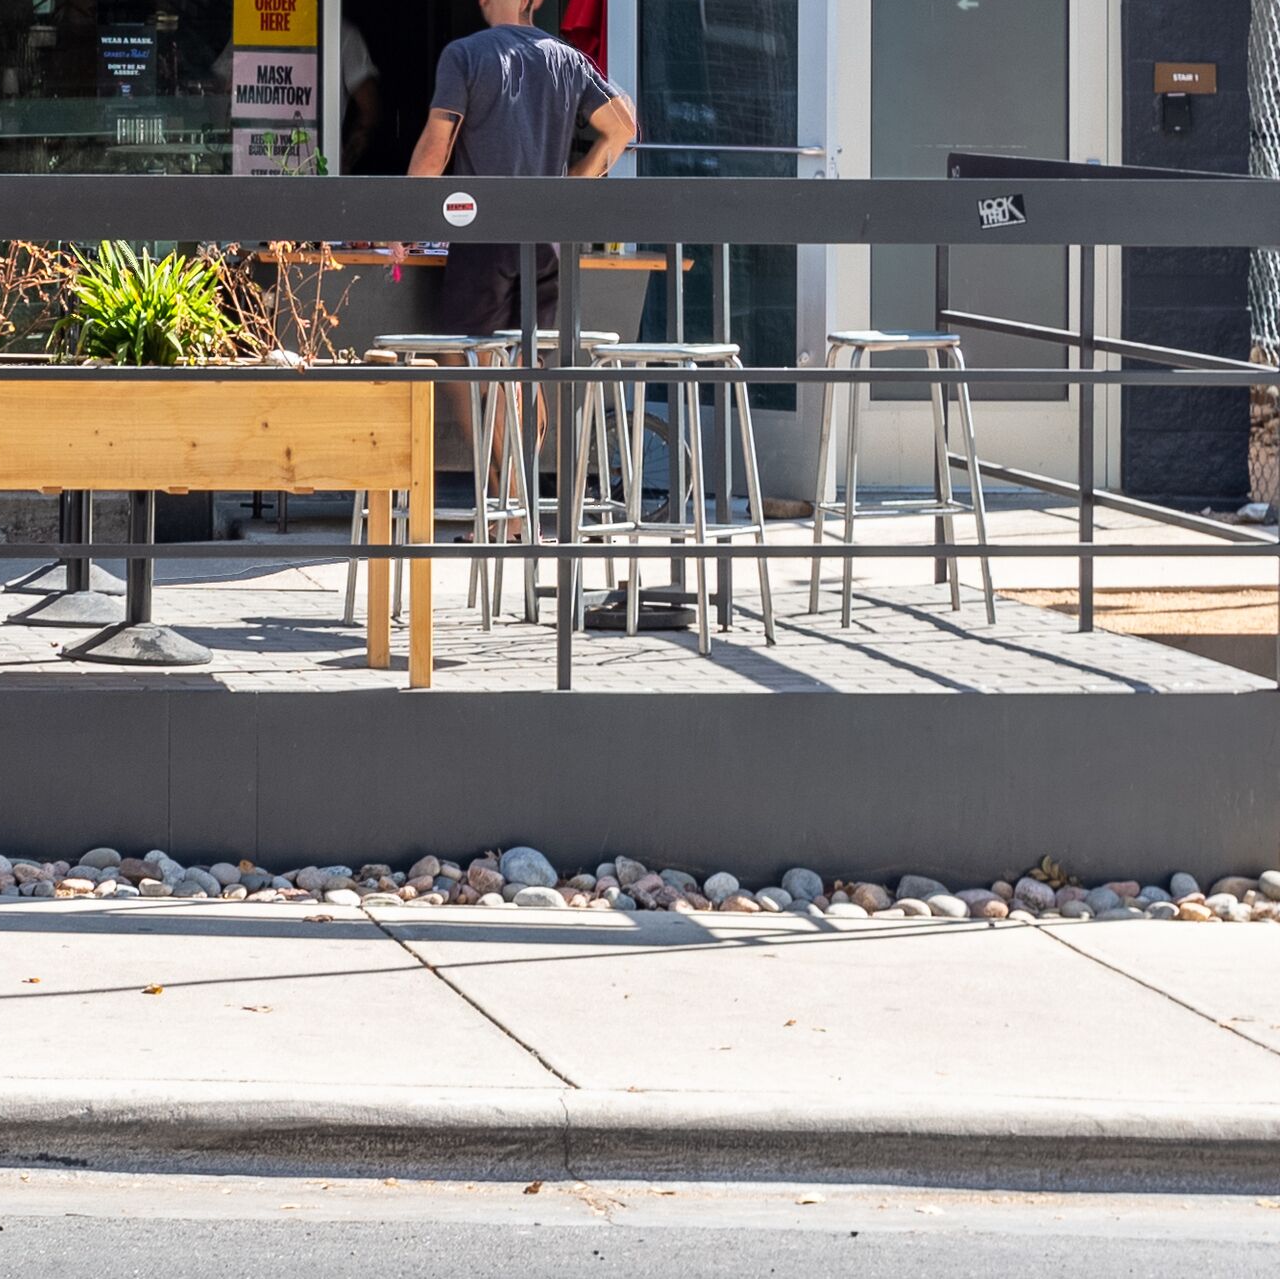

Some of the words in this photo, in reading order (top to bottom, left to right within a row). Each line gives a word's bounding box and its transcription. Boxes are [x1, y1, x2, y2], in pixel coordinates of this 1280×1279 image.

[260, 12, 291, 32] HERE
[256, 65, 293, 84] MASK
[1172, 72, 1194, 83] STAIR
[236, 84, 313, 106] MANDATORY
[978, 195, 1024, 218] LOOK
[980, 208, 1010, 225] THRU
